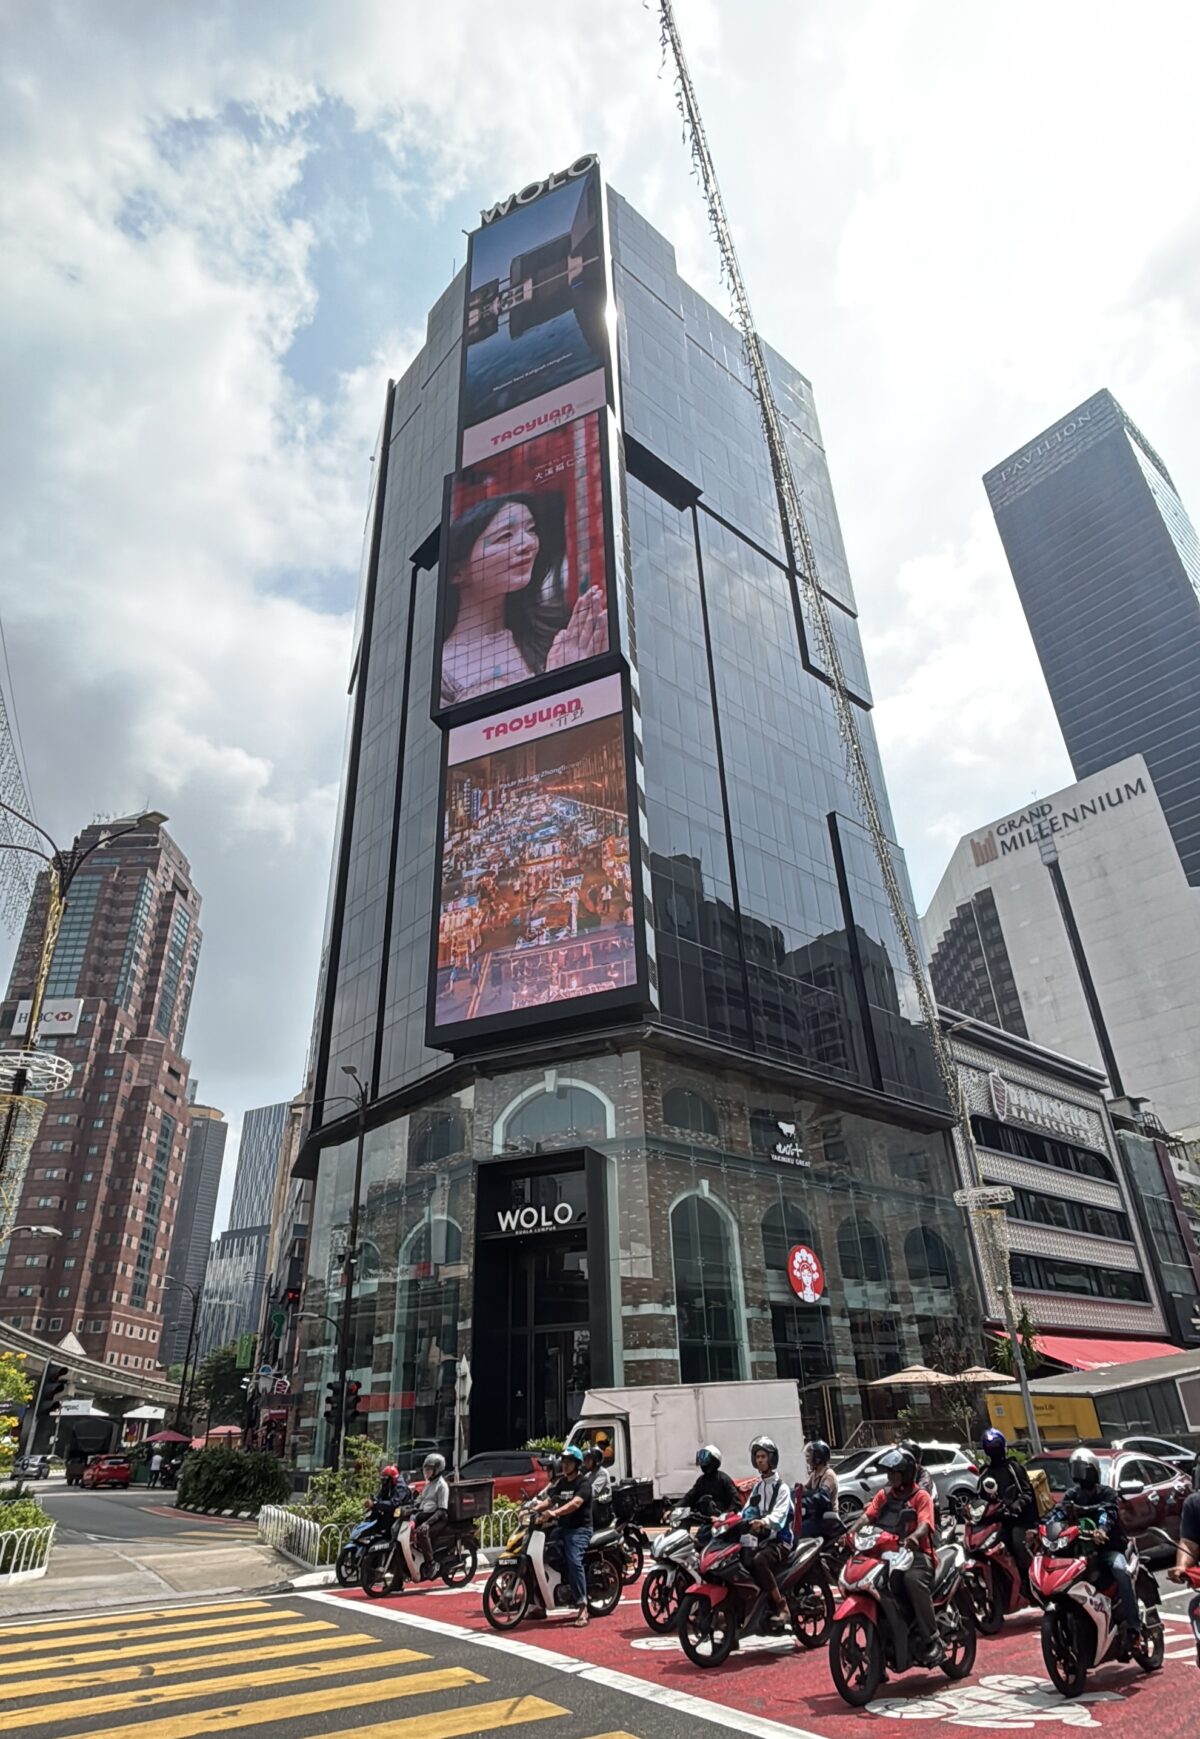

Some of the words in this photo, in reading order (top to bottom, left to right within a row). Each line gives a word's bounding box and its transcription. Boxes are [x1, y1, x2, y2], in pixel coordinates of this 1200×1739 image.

[480, 153, 598, 224] WOLO
[490, 403, 574, 446] TAOYUAN
[1001, 411, 1092, 481] PAVILION
[482, 698, 582, 740] TAOYUAN
[996, 803, 1053, 836] GRAND
[1000, 777, 1147, 856] MILLENNIUM
[497, 1202, 573, 1232] WOLO
